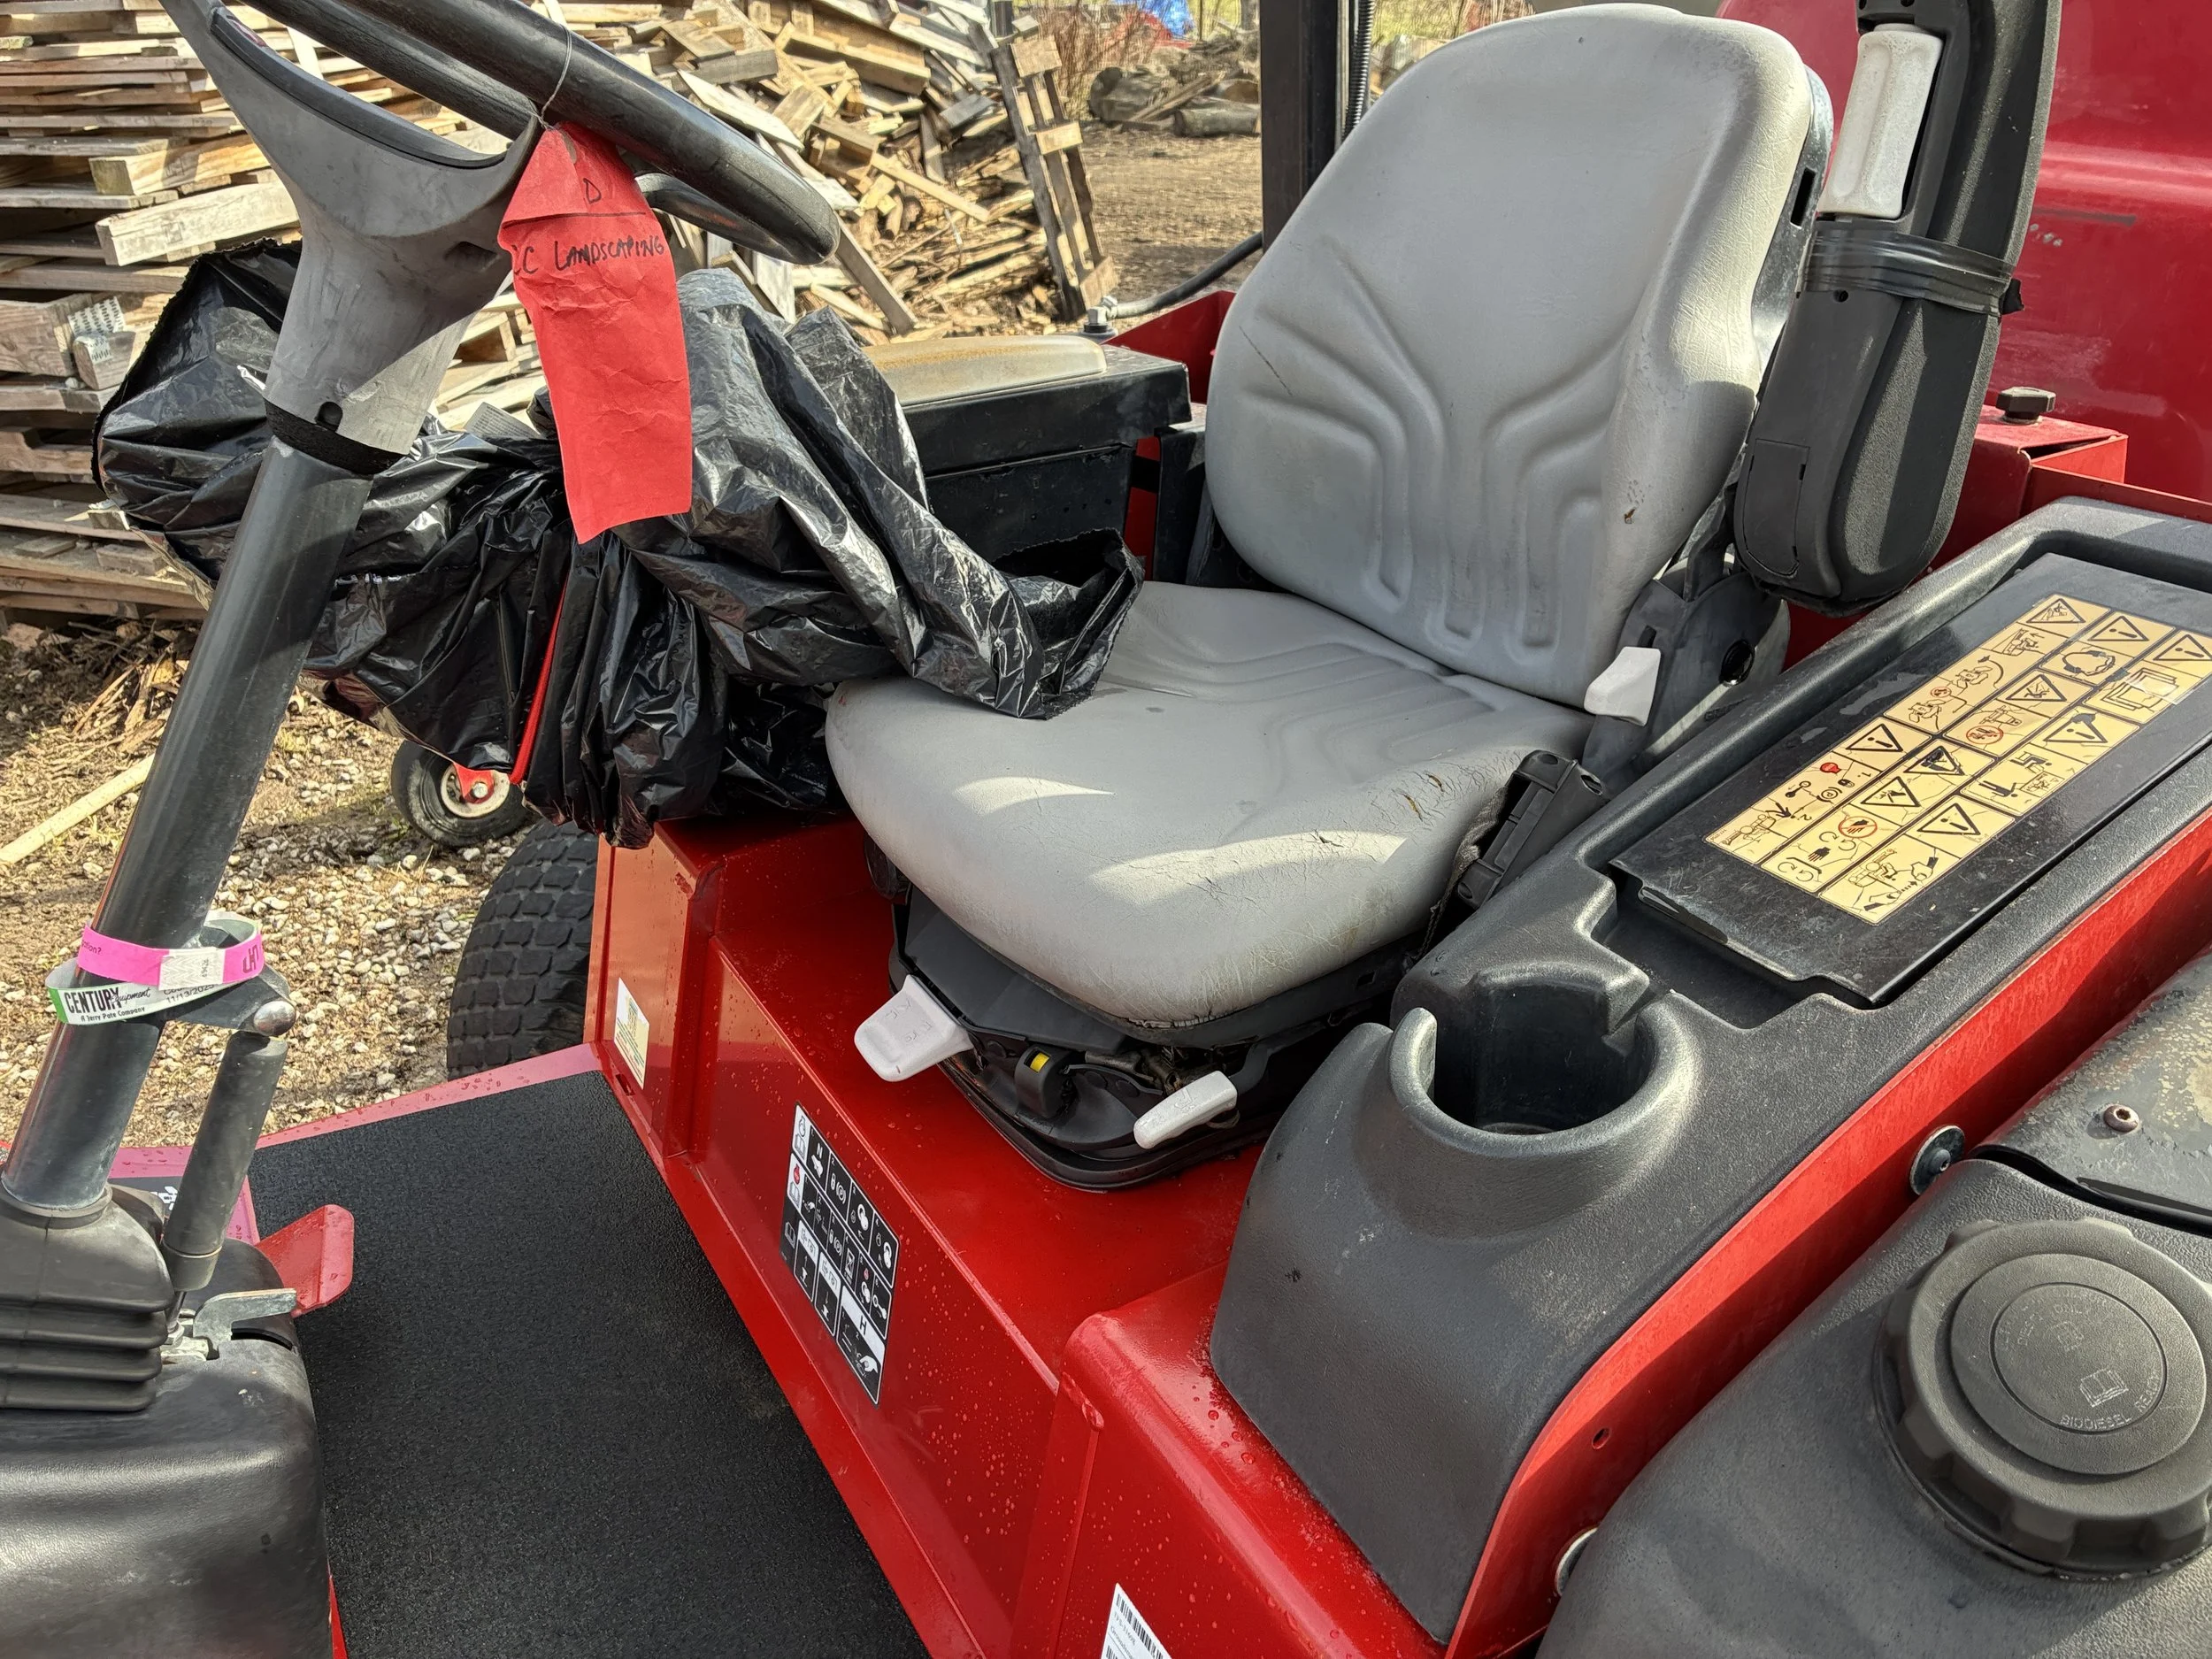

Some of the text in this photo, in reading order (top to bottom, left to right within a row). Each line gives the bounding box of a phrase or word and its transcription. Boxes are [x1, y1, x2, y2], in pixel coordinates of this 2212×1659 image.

[582, 177, 602, 204] D
[554, 234, 665, 271] LANDSCAPING
[64, 987, 122, 1014] CENTURY
[111, 987, 151, 1004] Equipment
[117, 1006, 146, 1017] Company
[817, 1142, 823, 1159] N
[859, 1315, 867, 1335] H
[2060, 1372, 2160, 1430] BIODIESEL READY
